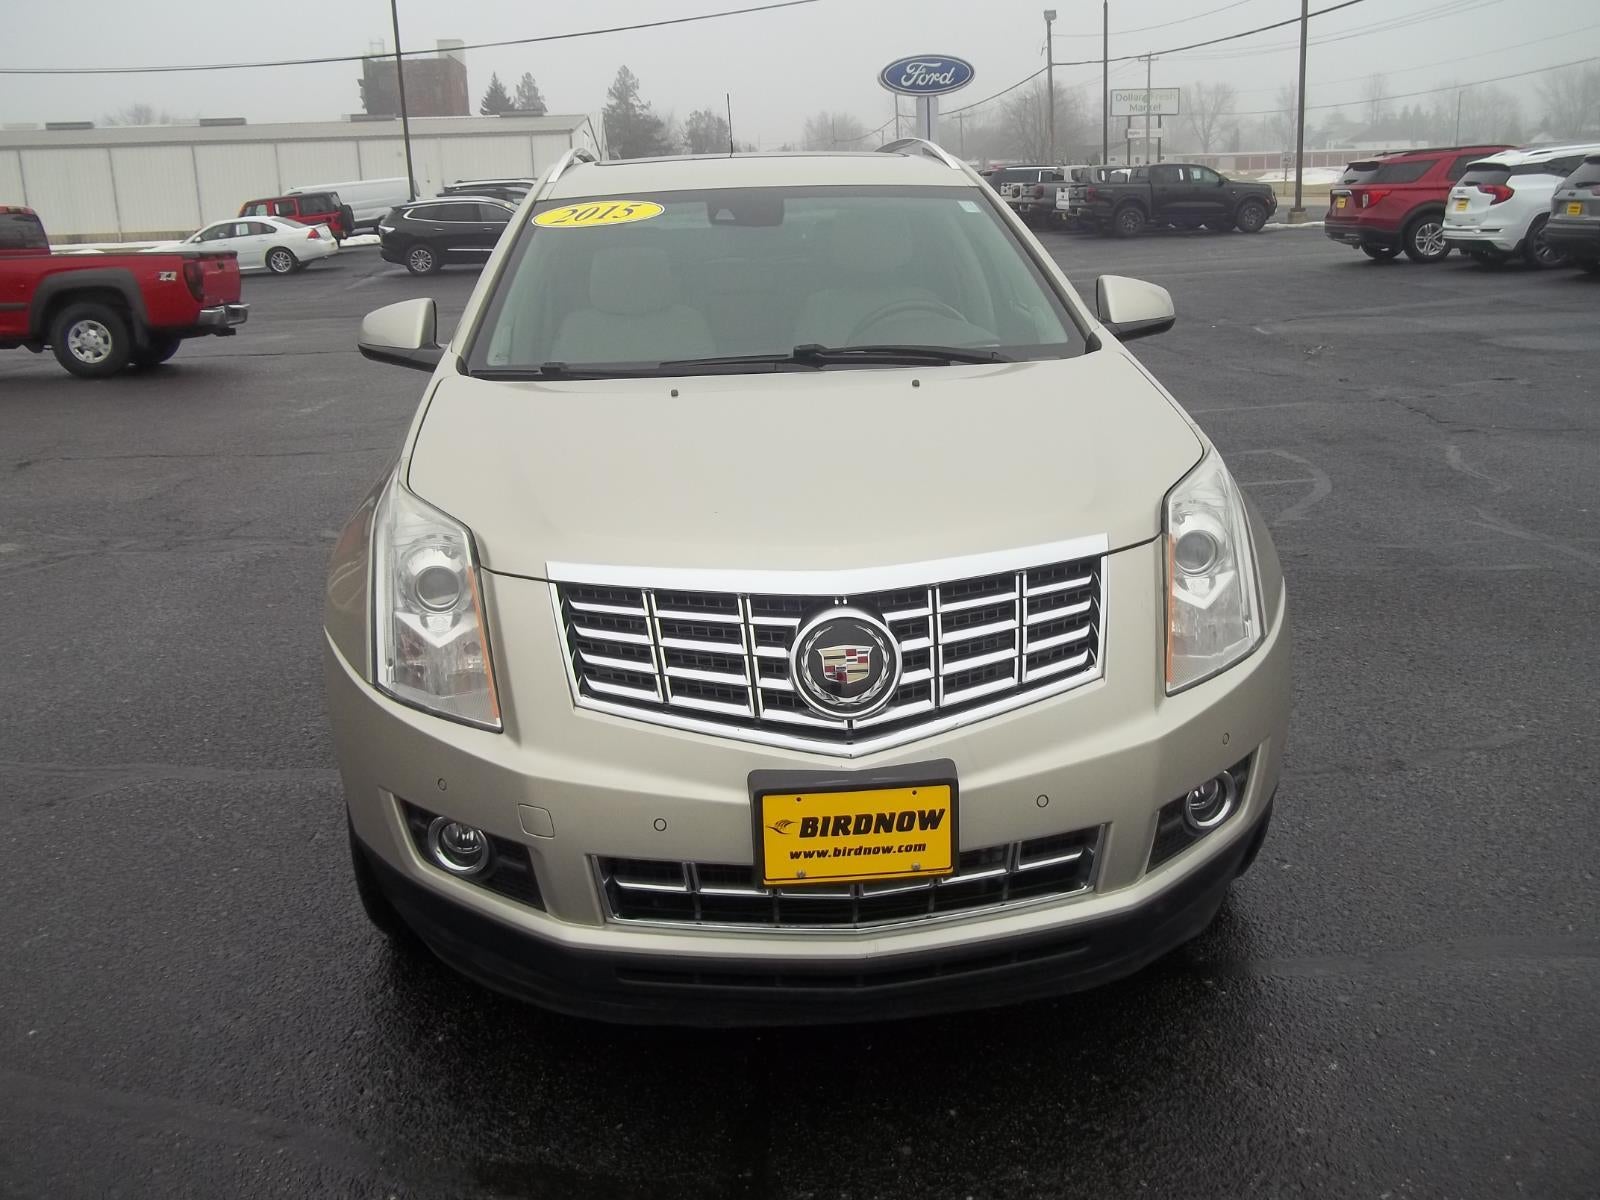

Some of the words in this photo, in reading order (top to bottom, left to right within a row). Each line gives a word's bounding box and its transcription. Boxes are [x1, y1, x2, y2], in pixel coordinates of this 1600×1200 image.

[901, 62, 955, 86] Ford
[1115, 93, 1141, 102] Dollar
[549, 204, 642, 224] 2015
[799, 809, 946, 838] BIRDNOW
[790, 843, 926, 859] www.birdnow.com
